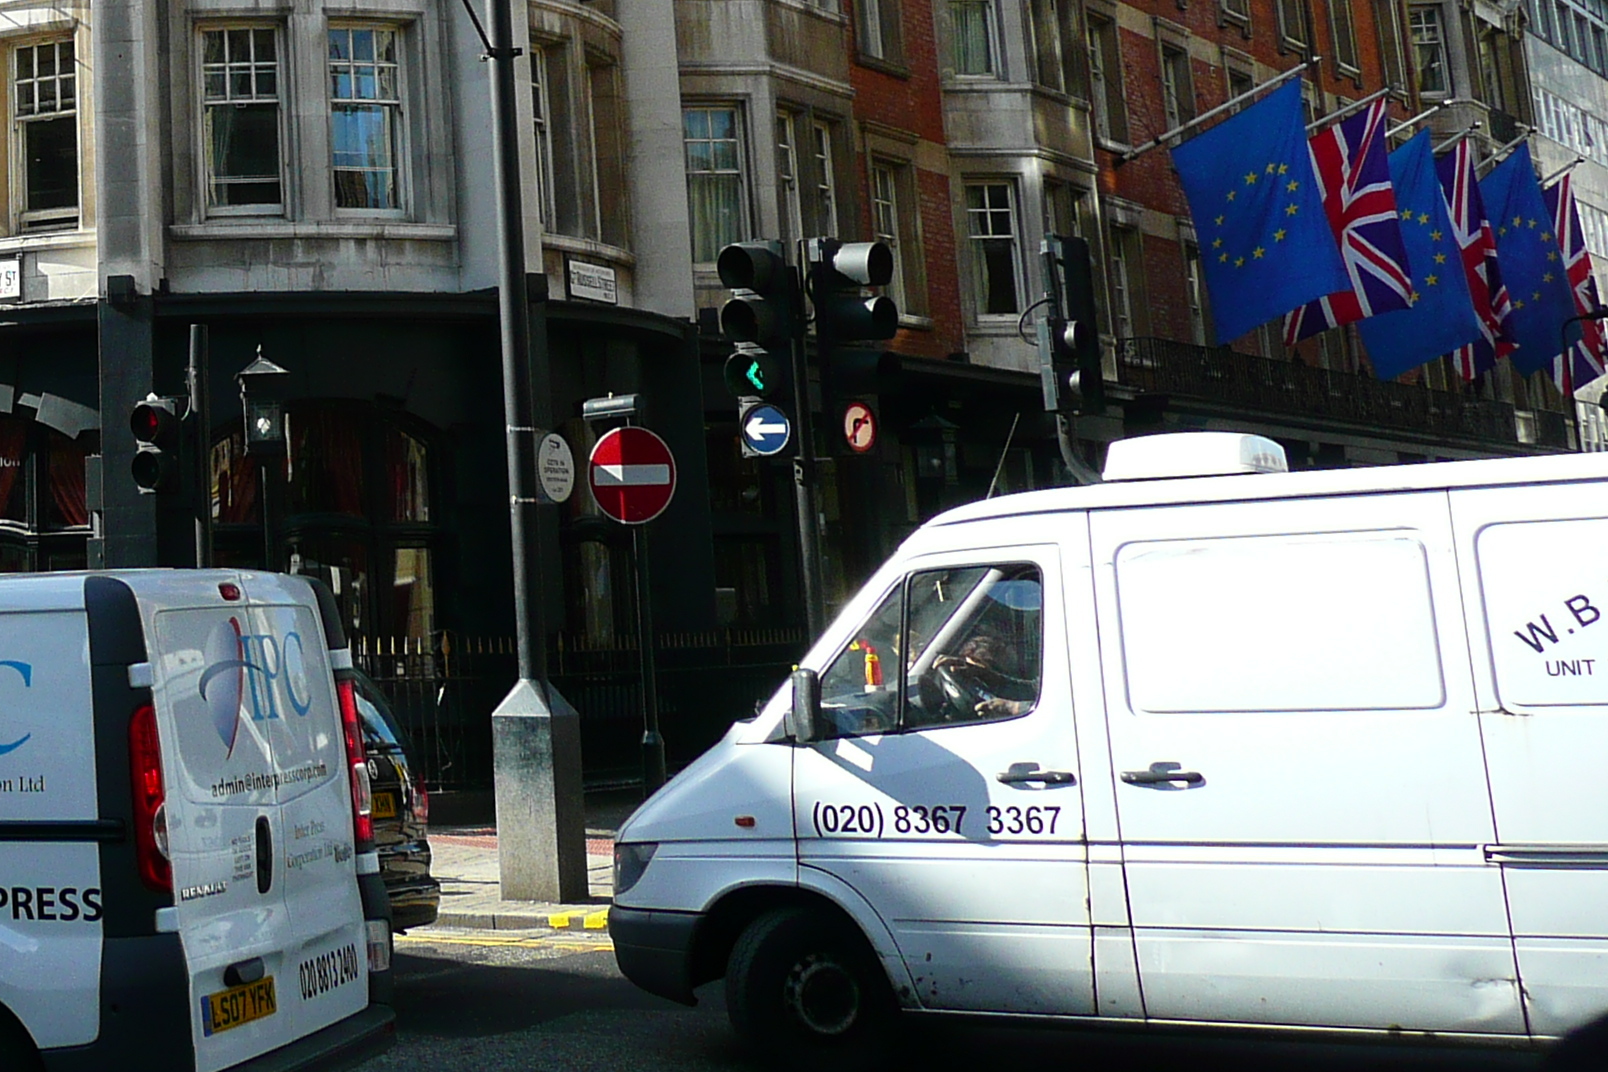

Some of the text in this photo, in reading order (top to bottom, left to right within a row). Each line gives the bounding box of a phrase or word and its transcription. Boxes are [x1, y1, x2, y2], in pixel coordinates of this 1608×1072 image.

[239, 631, 312, 721] IPC
[1545, 659, 1596, 676] UNIT
[19, 775, 45, 792] Ltd
[211, 764, 327, 797] admin@interpresscorp.com
[813, 801, 1061, 839] (020) 8367 3367
[181, 880, 228, 902] RENAULT
[299, 943, 359, 1001] 020 8813 2400
[211, 981, 275, 1029] LS07 YFX
